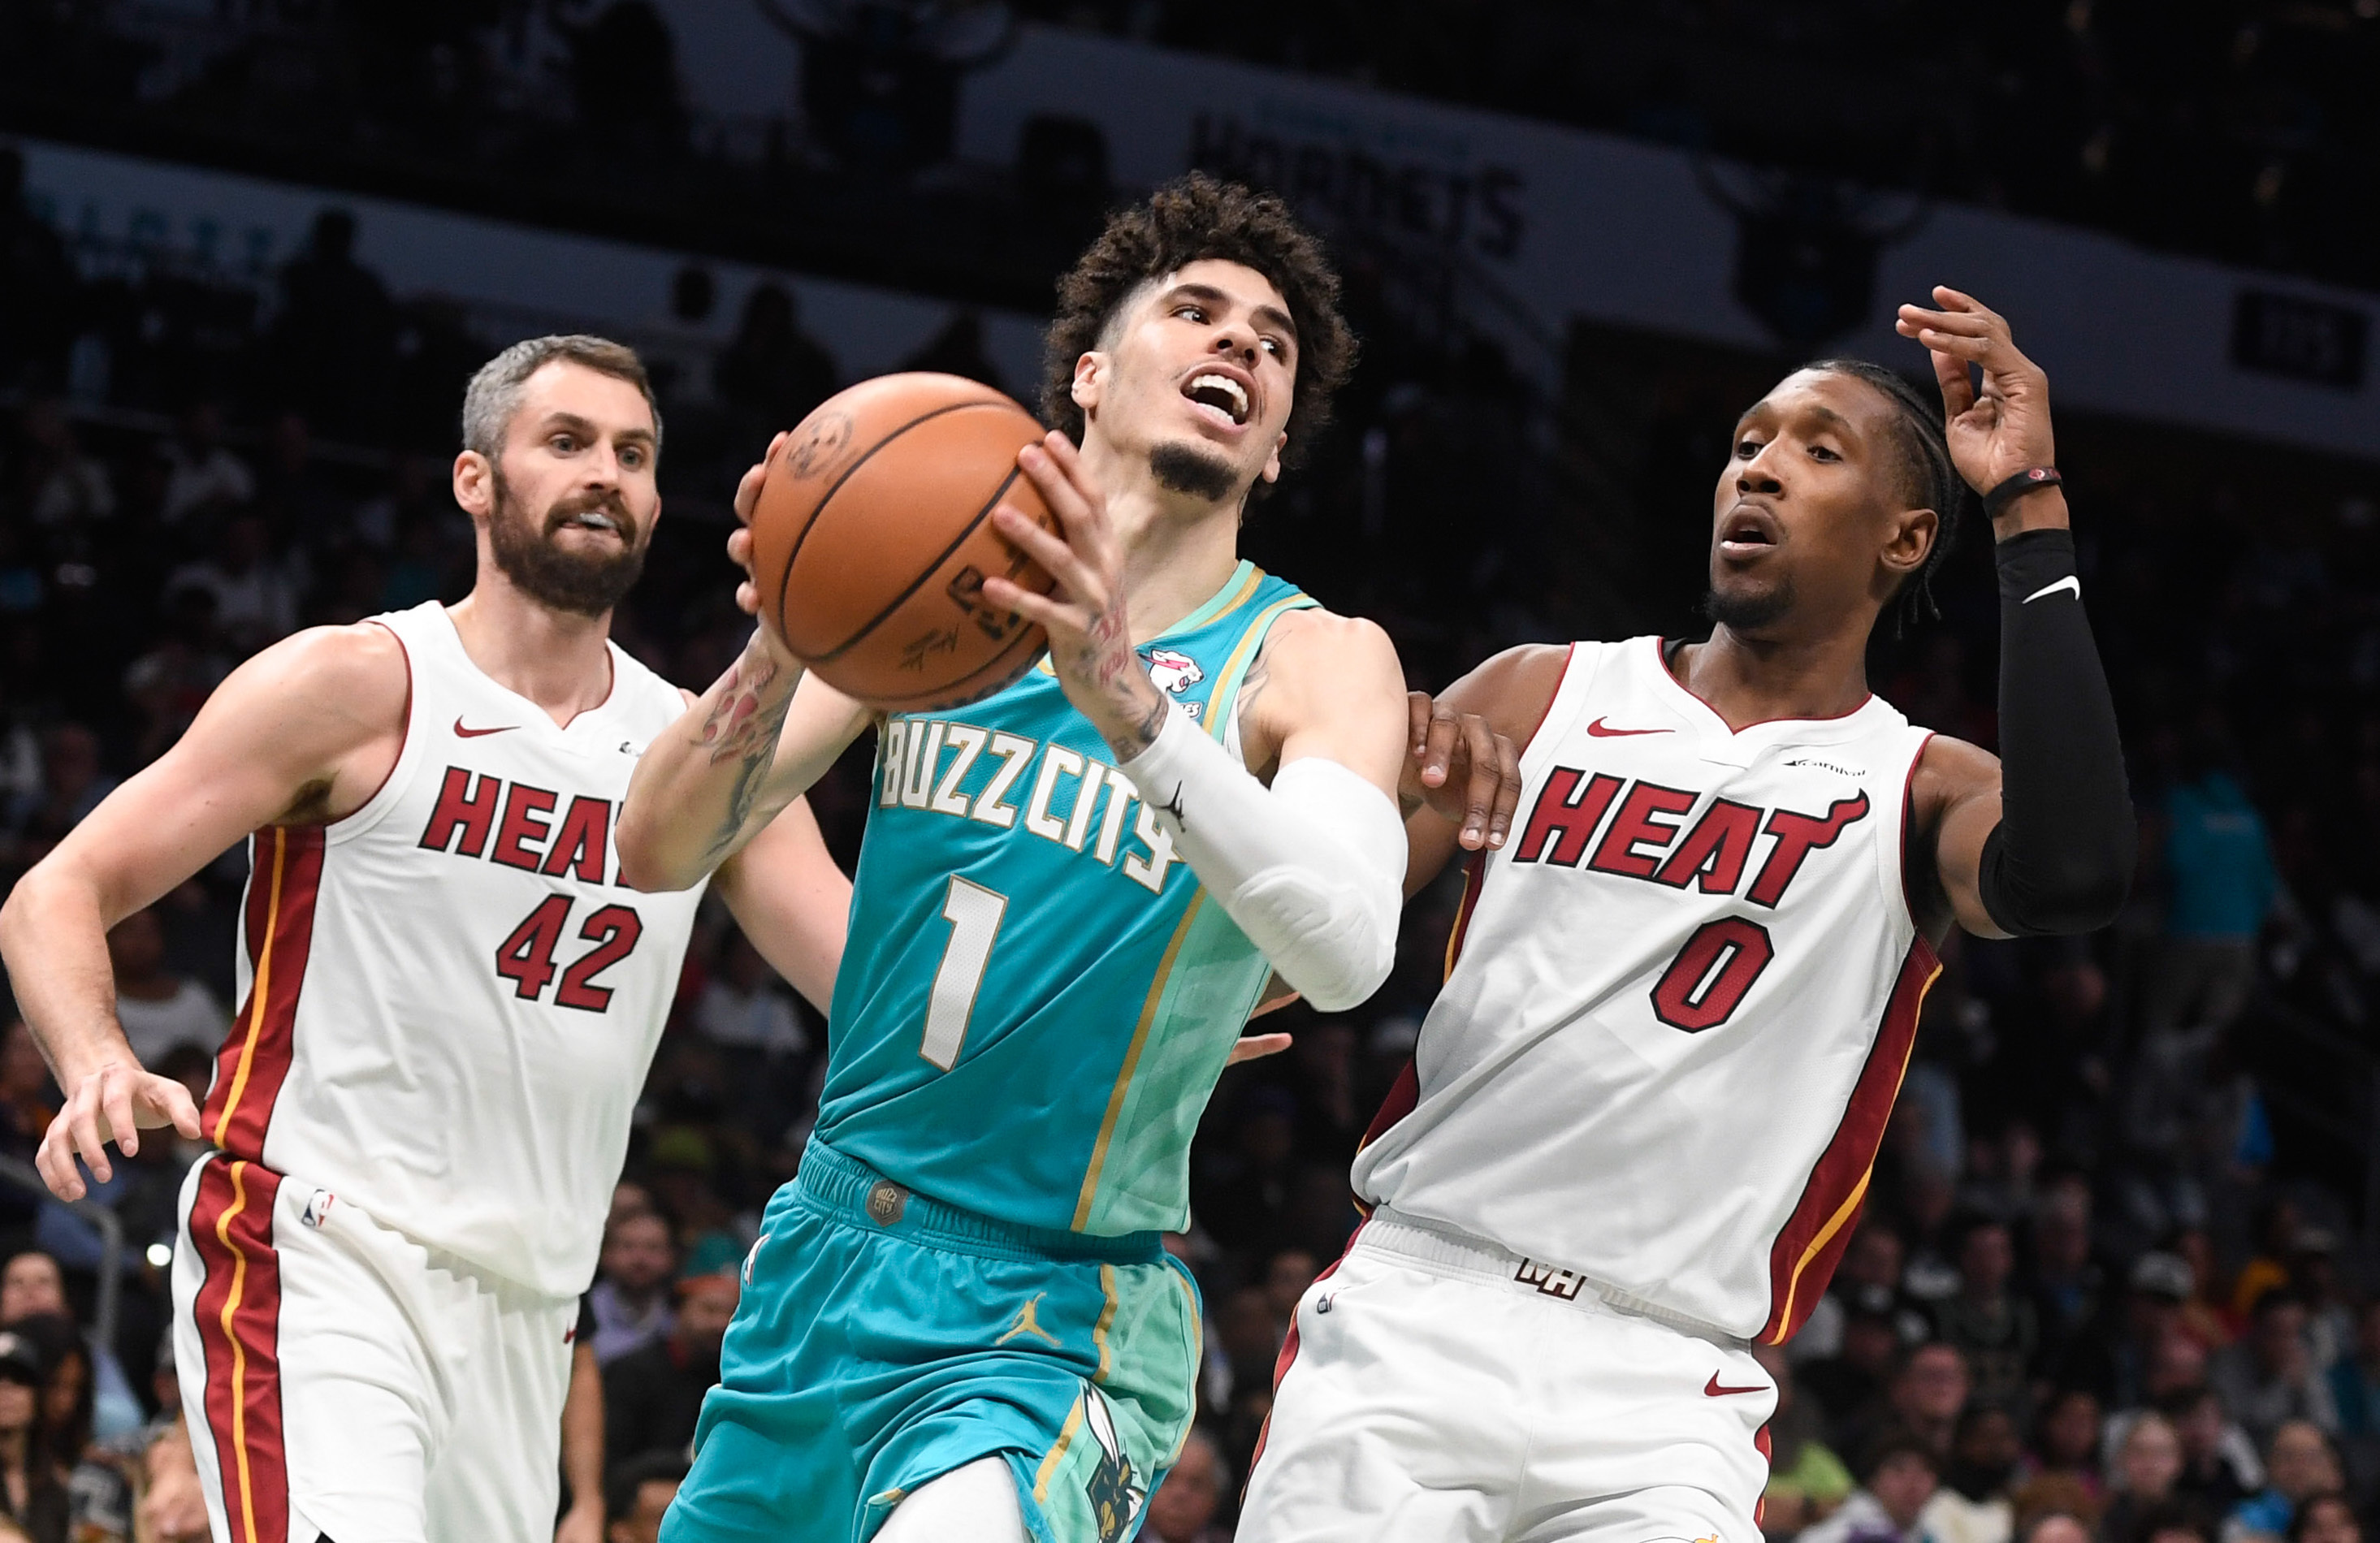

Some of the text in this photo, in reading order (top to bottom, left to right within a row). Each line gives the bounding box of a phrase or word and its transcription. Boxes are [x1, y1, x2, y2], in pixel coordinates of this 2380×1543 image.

[417, 765, 634, 888] HEA
[1512, 765, 1870, 910] HEAT
[495, 893, 643, 1014] 42
[918, 874, 1009, 1073] 1
[1650, 915, 1775, 1034] 0
